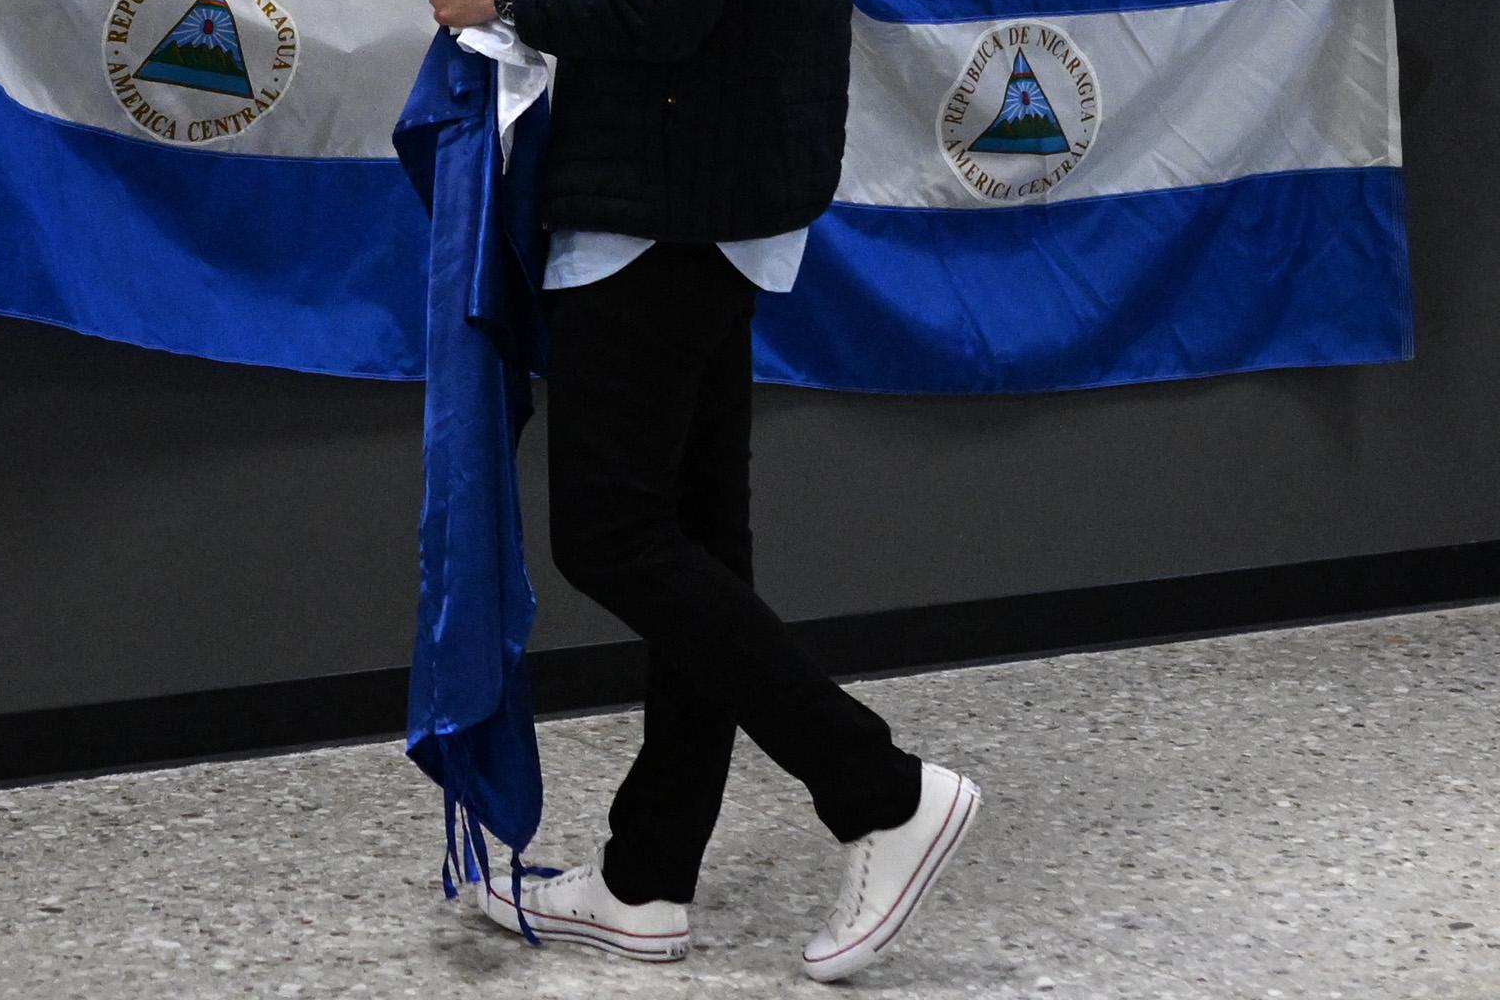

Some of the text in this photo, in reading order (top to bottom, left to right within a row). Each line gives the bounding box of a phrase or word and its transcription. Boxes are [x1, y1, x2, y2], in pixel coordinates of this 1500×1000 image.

[107, 62, 280, 142] AMERICA CENTRAL
[945, 26, 1095, 125] REPUBLICA DE NICARAGUA
[1018, 139, 1090, 197] CENTRAL
